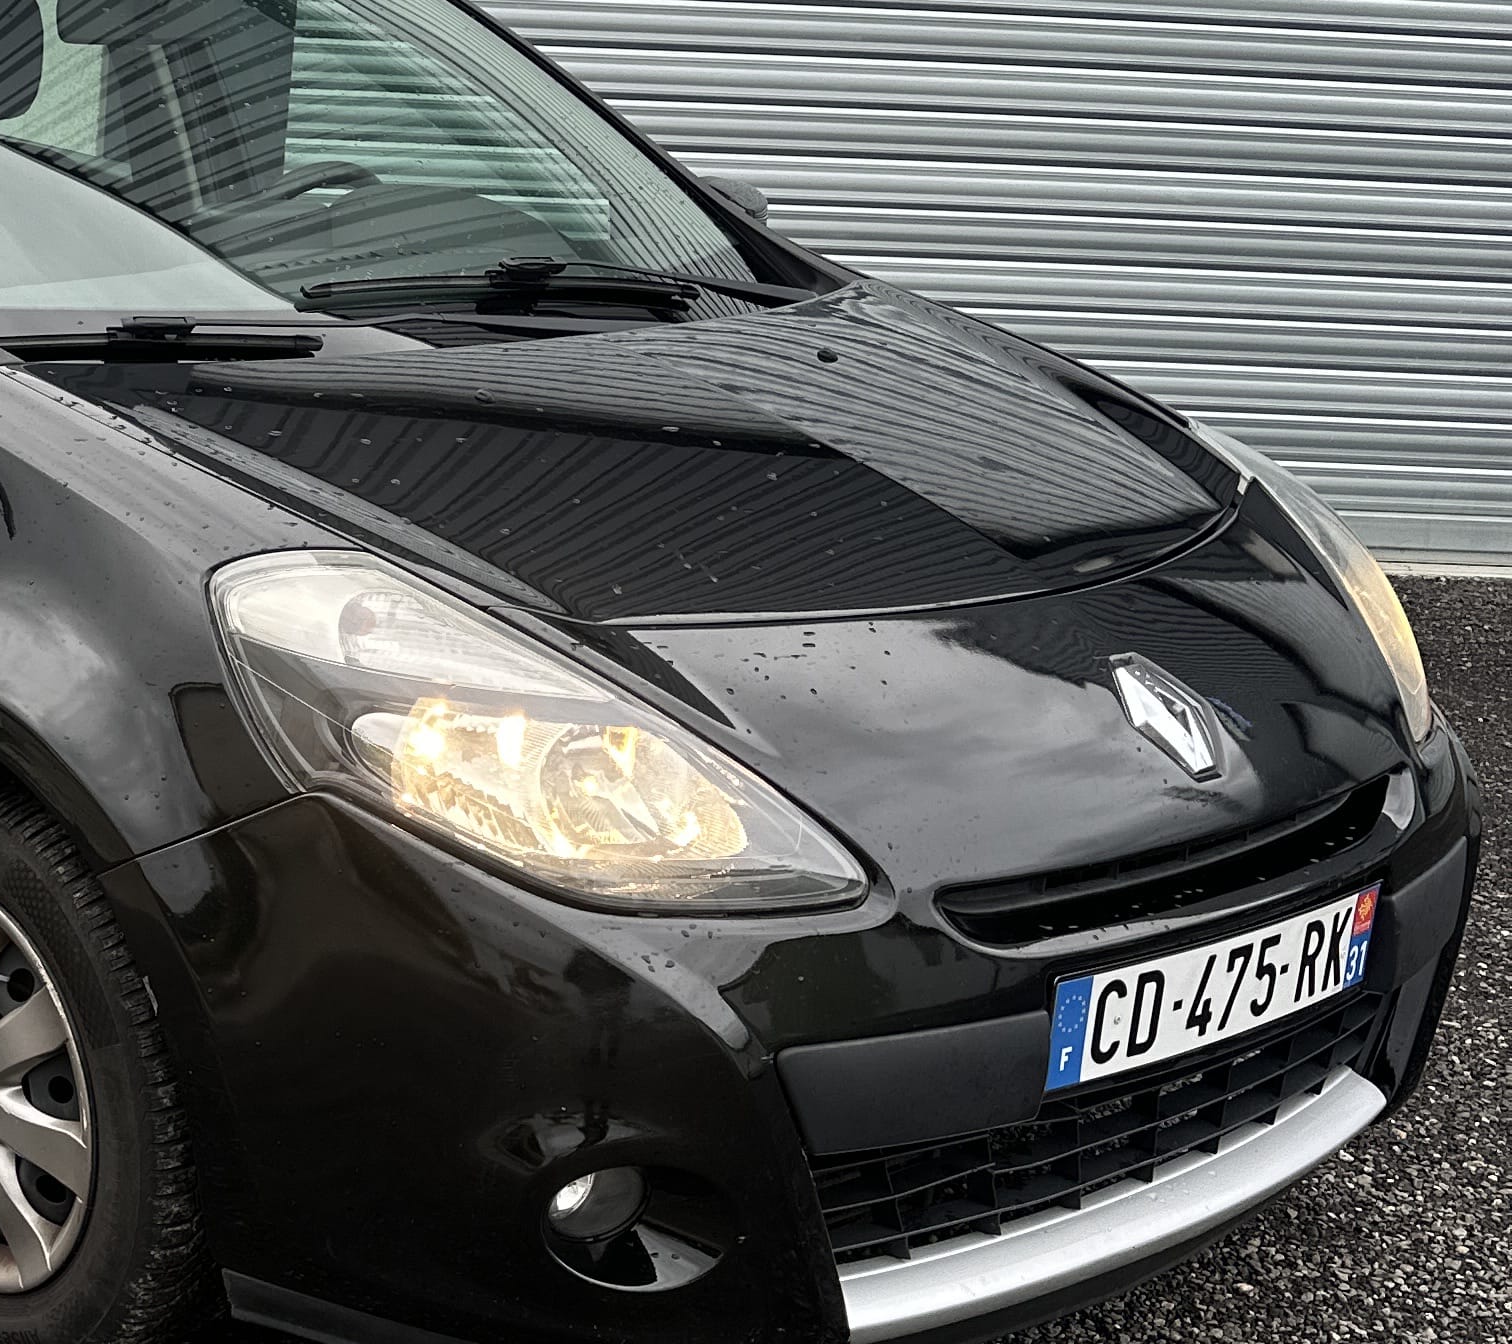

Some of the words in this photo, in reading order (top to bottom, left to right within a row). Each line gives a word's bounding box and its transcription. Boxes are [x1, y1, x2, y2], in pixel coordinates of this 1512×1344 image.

[1345, 940, 1369, 982] 31
[1089, 906, 1354, 1065] CD-475-RK
[1058, 1046, 1073, 1072] F
